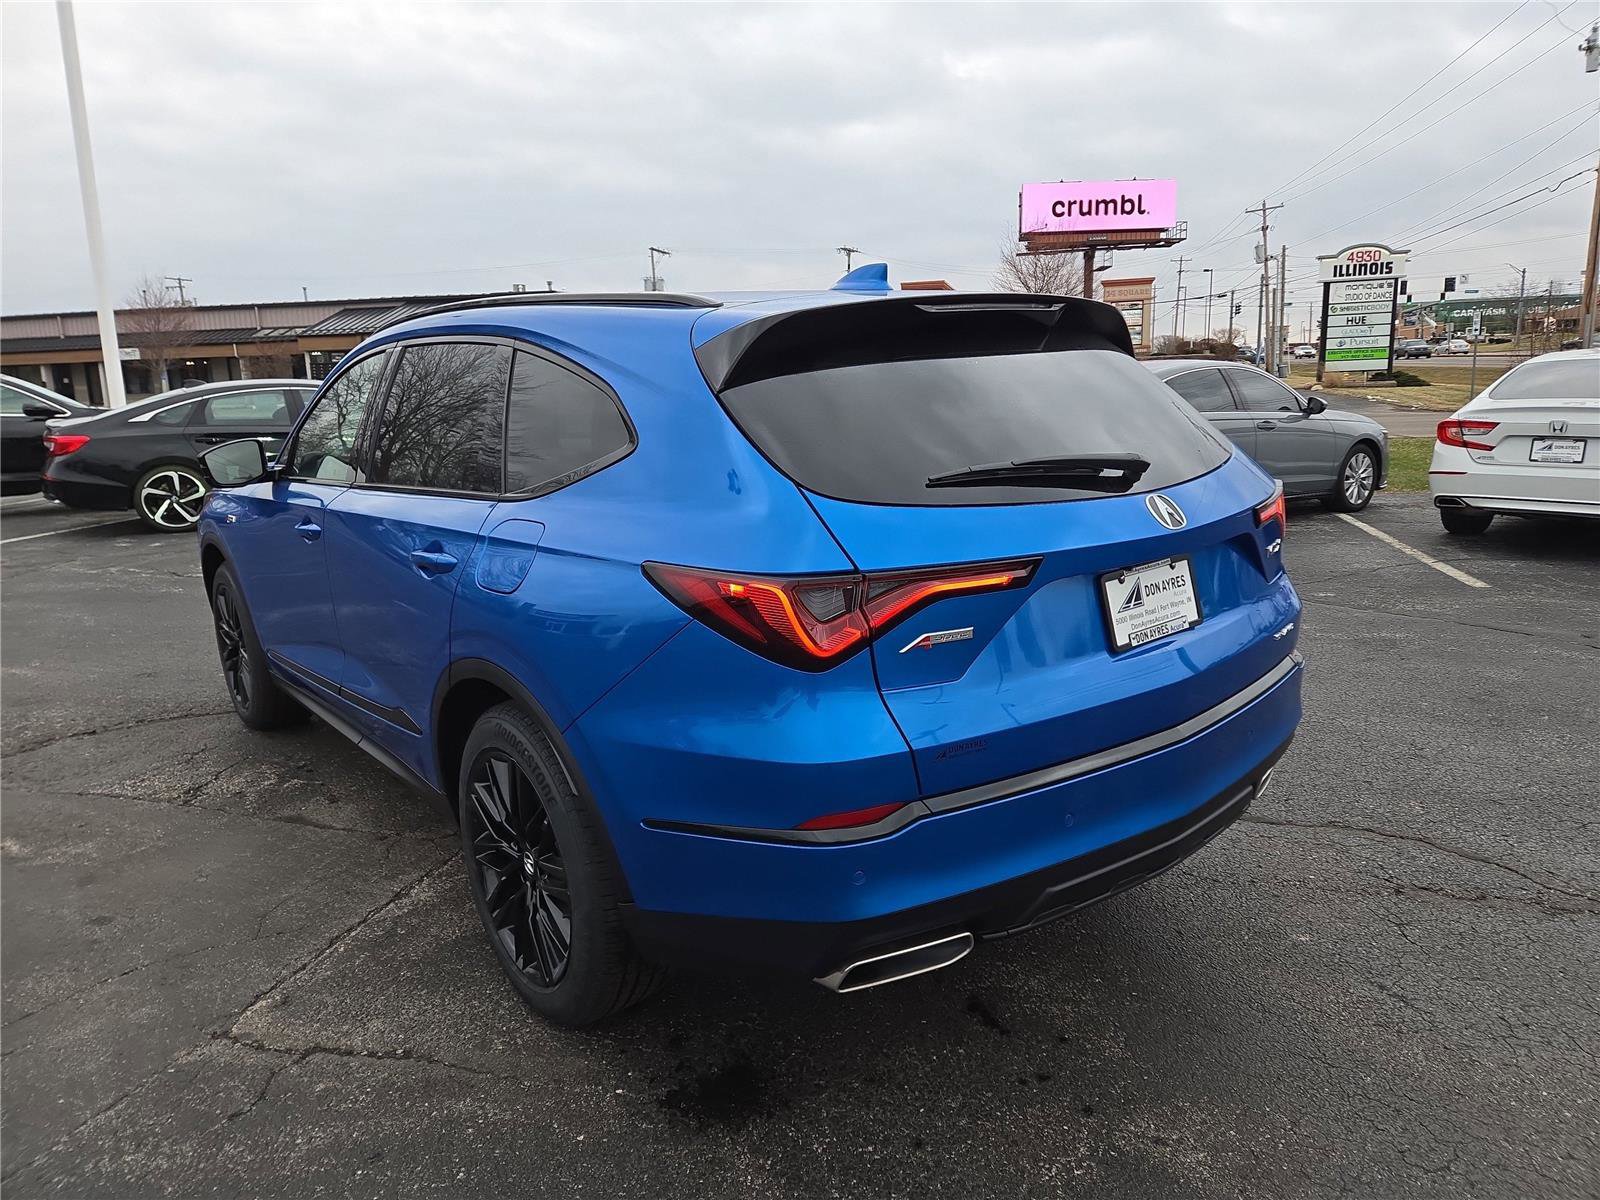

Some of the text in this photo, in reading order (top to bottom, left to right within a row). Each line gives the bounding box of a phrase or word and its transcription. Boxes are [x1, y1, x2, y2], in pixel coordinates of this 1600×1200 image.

[1347, 250, 1382, 263] 4930
[1333, 261, 1394, 278] ILLINOIS
[1345, 281, 1393, 291] monique's
[1344, 291, 1392, 301] STUDIO OF DANCE
[1346, 315, 1367, 325] HUE
[1454, 309, 1474, 317] CAR
[1144, 574, 1186, 597] DON AYRES
[1115, 616, 1128, 626] 5000
[1129, 612, 1144, 621] Illinois
[1145, 607, 1157, 616] Road
[1160, 603, 1170, 612] Fort
[1131, 610, 1181, 631] DonAyresAcura.com
[1135, 622, 1184, 643] DON AYRES Acura
